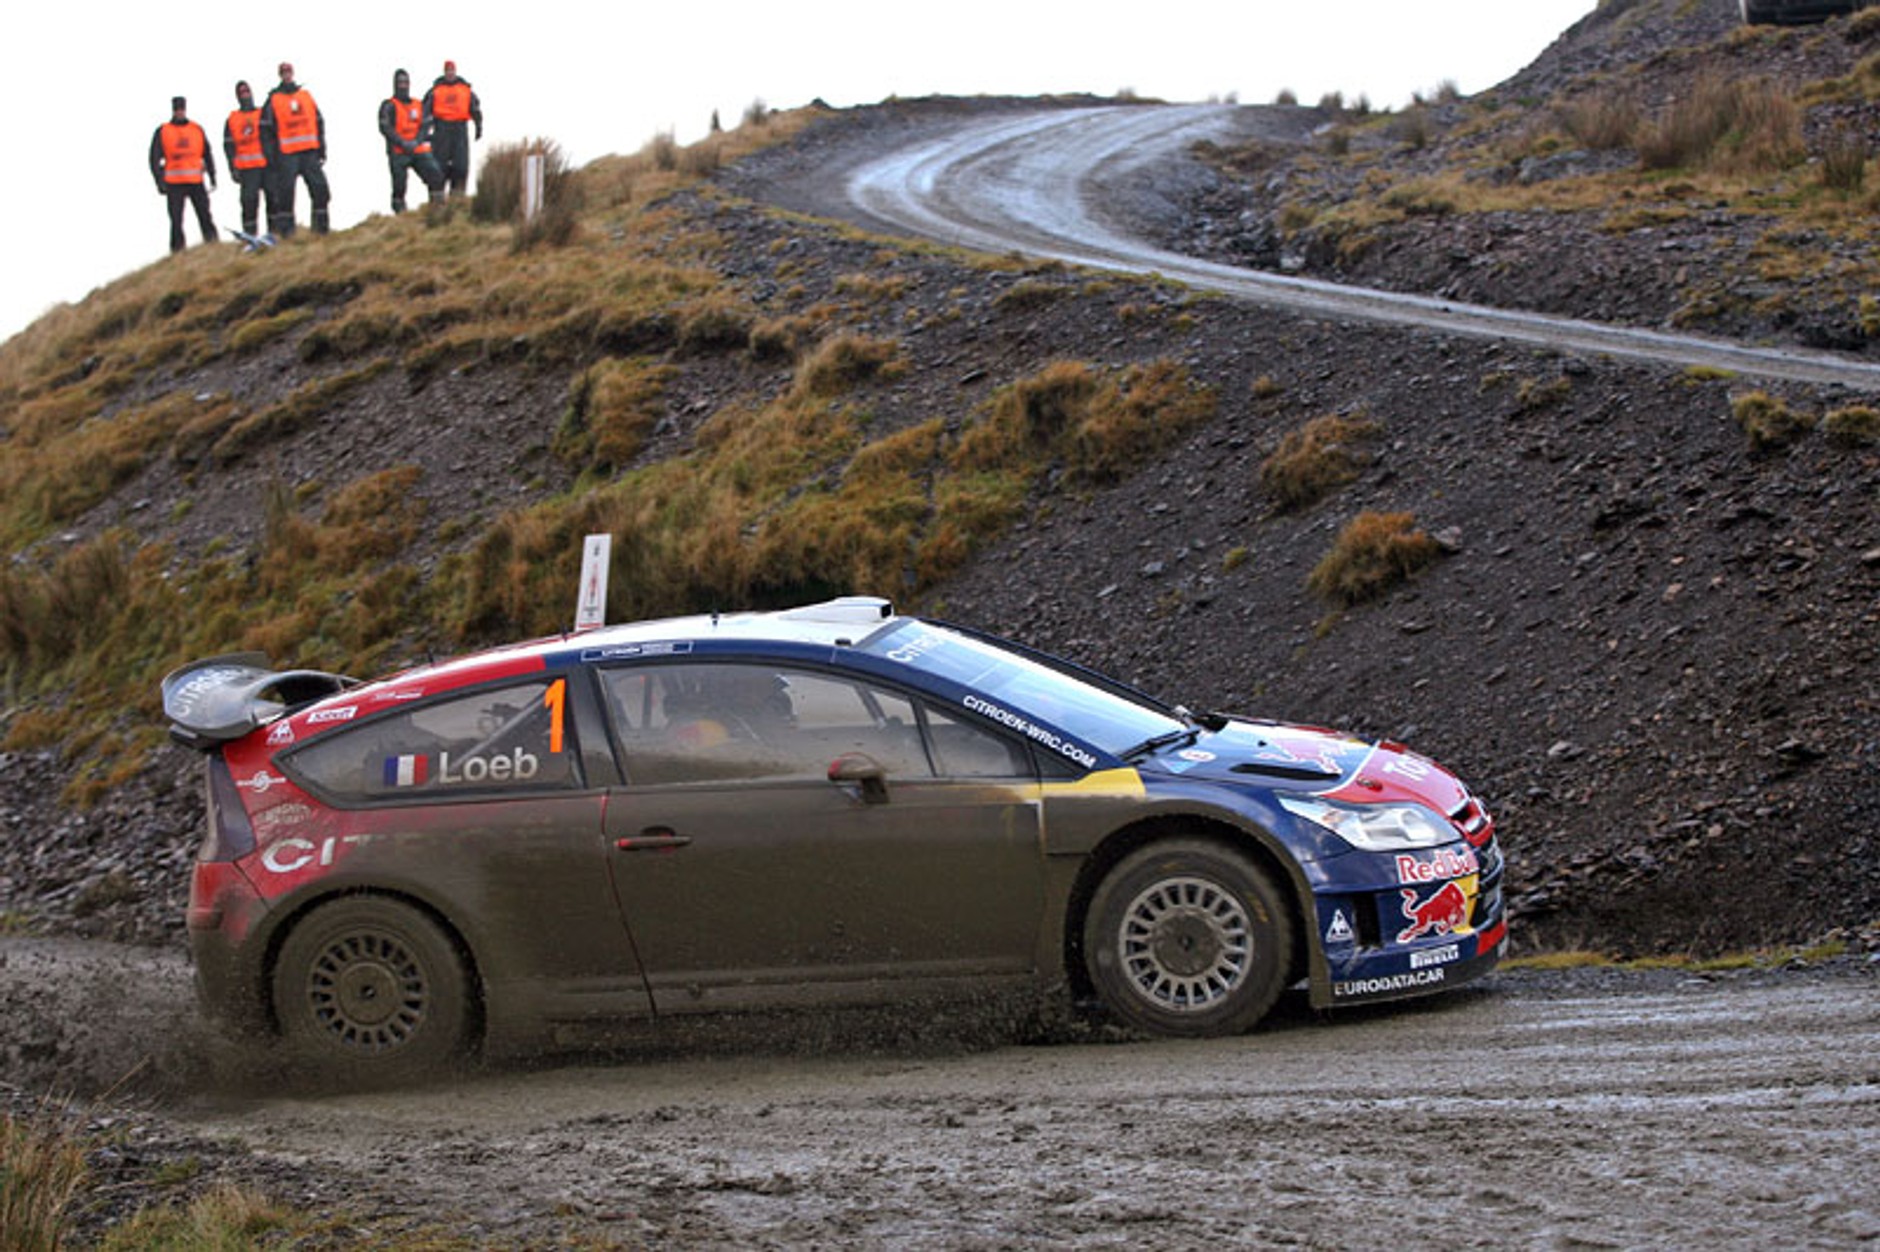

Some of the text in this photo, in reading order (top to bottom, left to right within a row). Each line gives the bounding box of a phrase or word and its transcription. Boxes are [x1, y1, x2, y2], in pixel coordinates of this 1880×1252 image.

[545, 679, 566, 753] 1
[439, 747, 538, 784] Loeb
[1397, 850, 1449, 883] Red
[1411, 944, 1459, 969] PIRELLI
[1335, 968, 1445, 995] EURODATACAR
